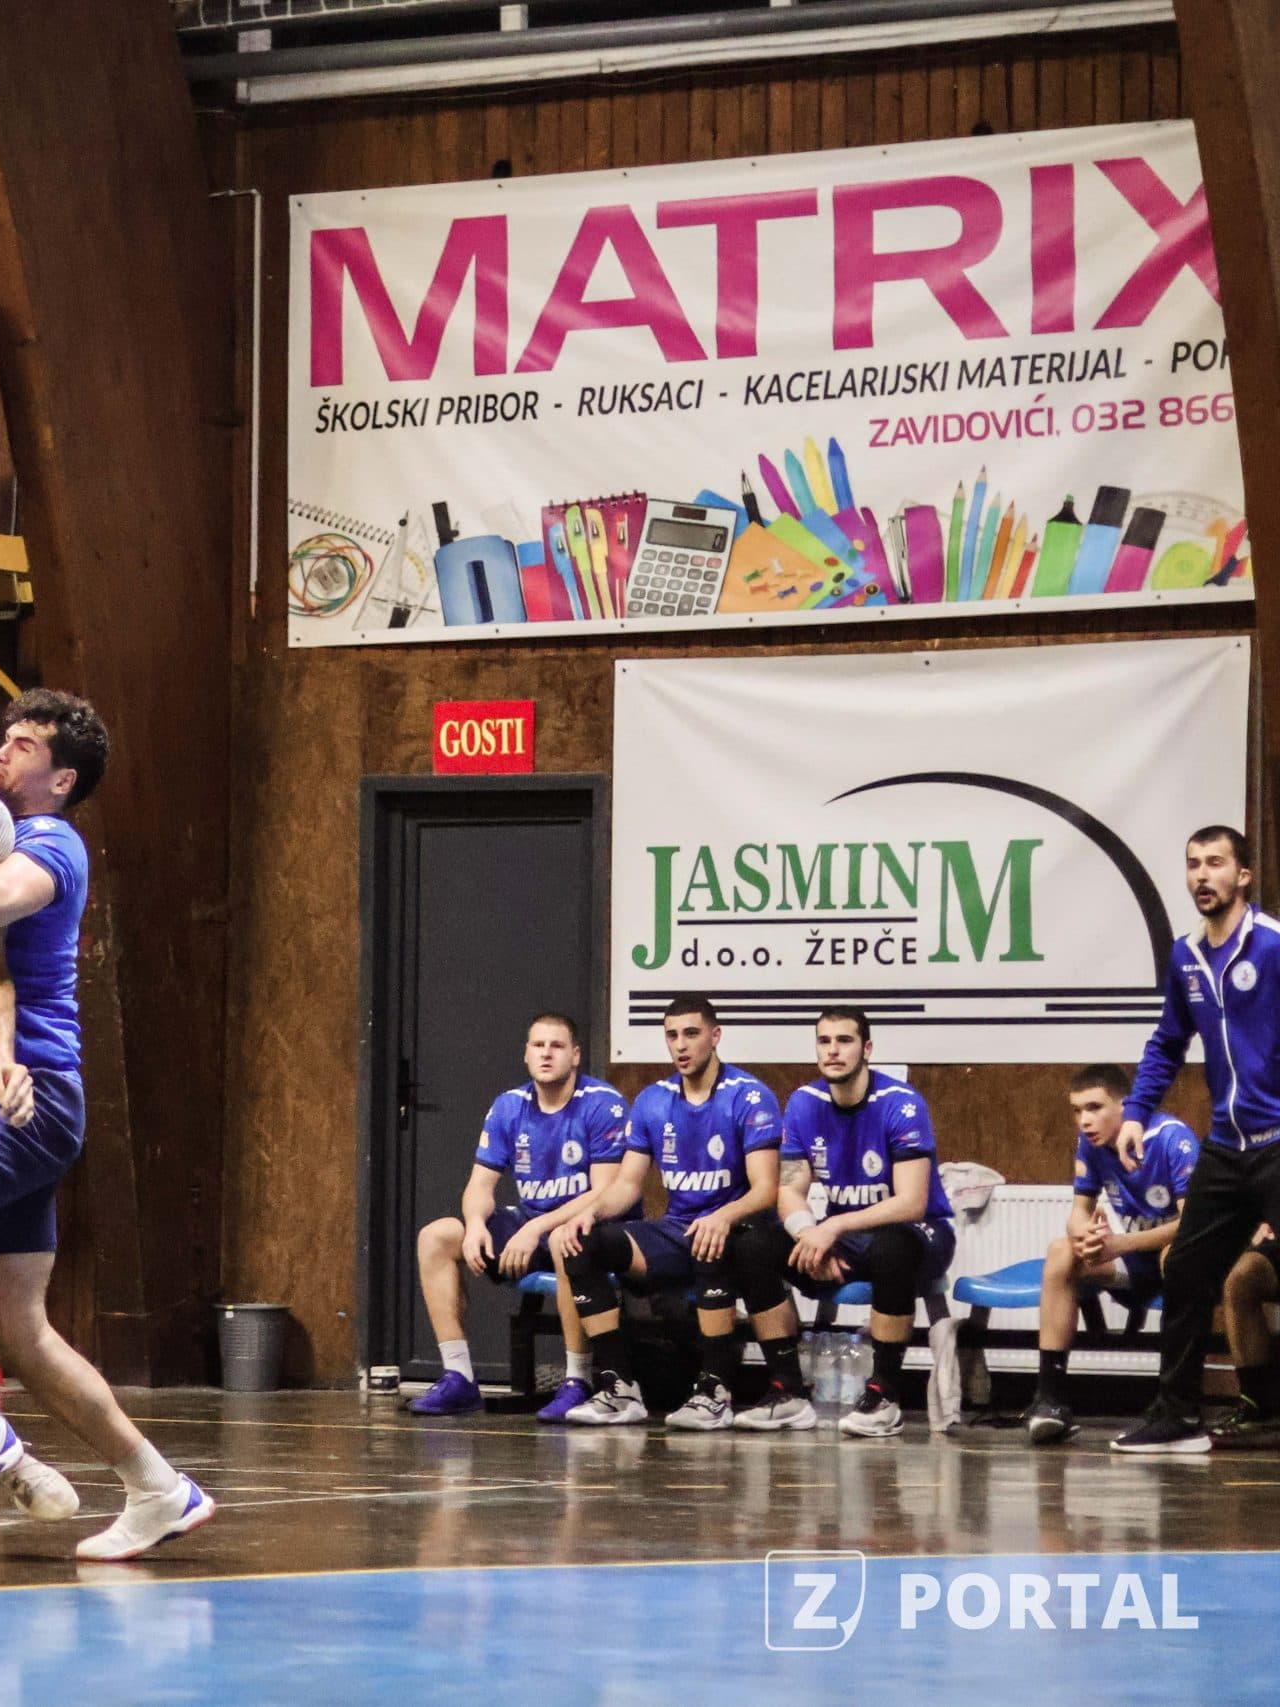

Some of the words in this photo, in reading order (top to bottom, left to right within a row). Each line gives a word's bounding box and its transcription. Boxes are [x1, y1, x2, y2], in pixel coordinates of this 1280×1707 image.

[309, 157, 1224, 388] MATRIX
[314, 397, 430, 434] ŠKOLSKI
[435, 390, 540, 427] PRIBOR
[576, 379, 704, 417] RUKSACI
[743, 361, 950, 405] KACELARIJSKI
[956, 347, 1128, 390] MATERIJAL
[1072, 399, 1146, 433] 032
[1158, 392, 1235, 428] 866
[439, 718, 526, 758] GOSTI
[681, 938, 783, 967] d.o.o.
[805, 929, 918, 966] ŽEPČE
